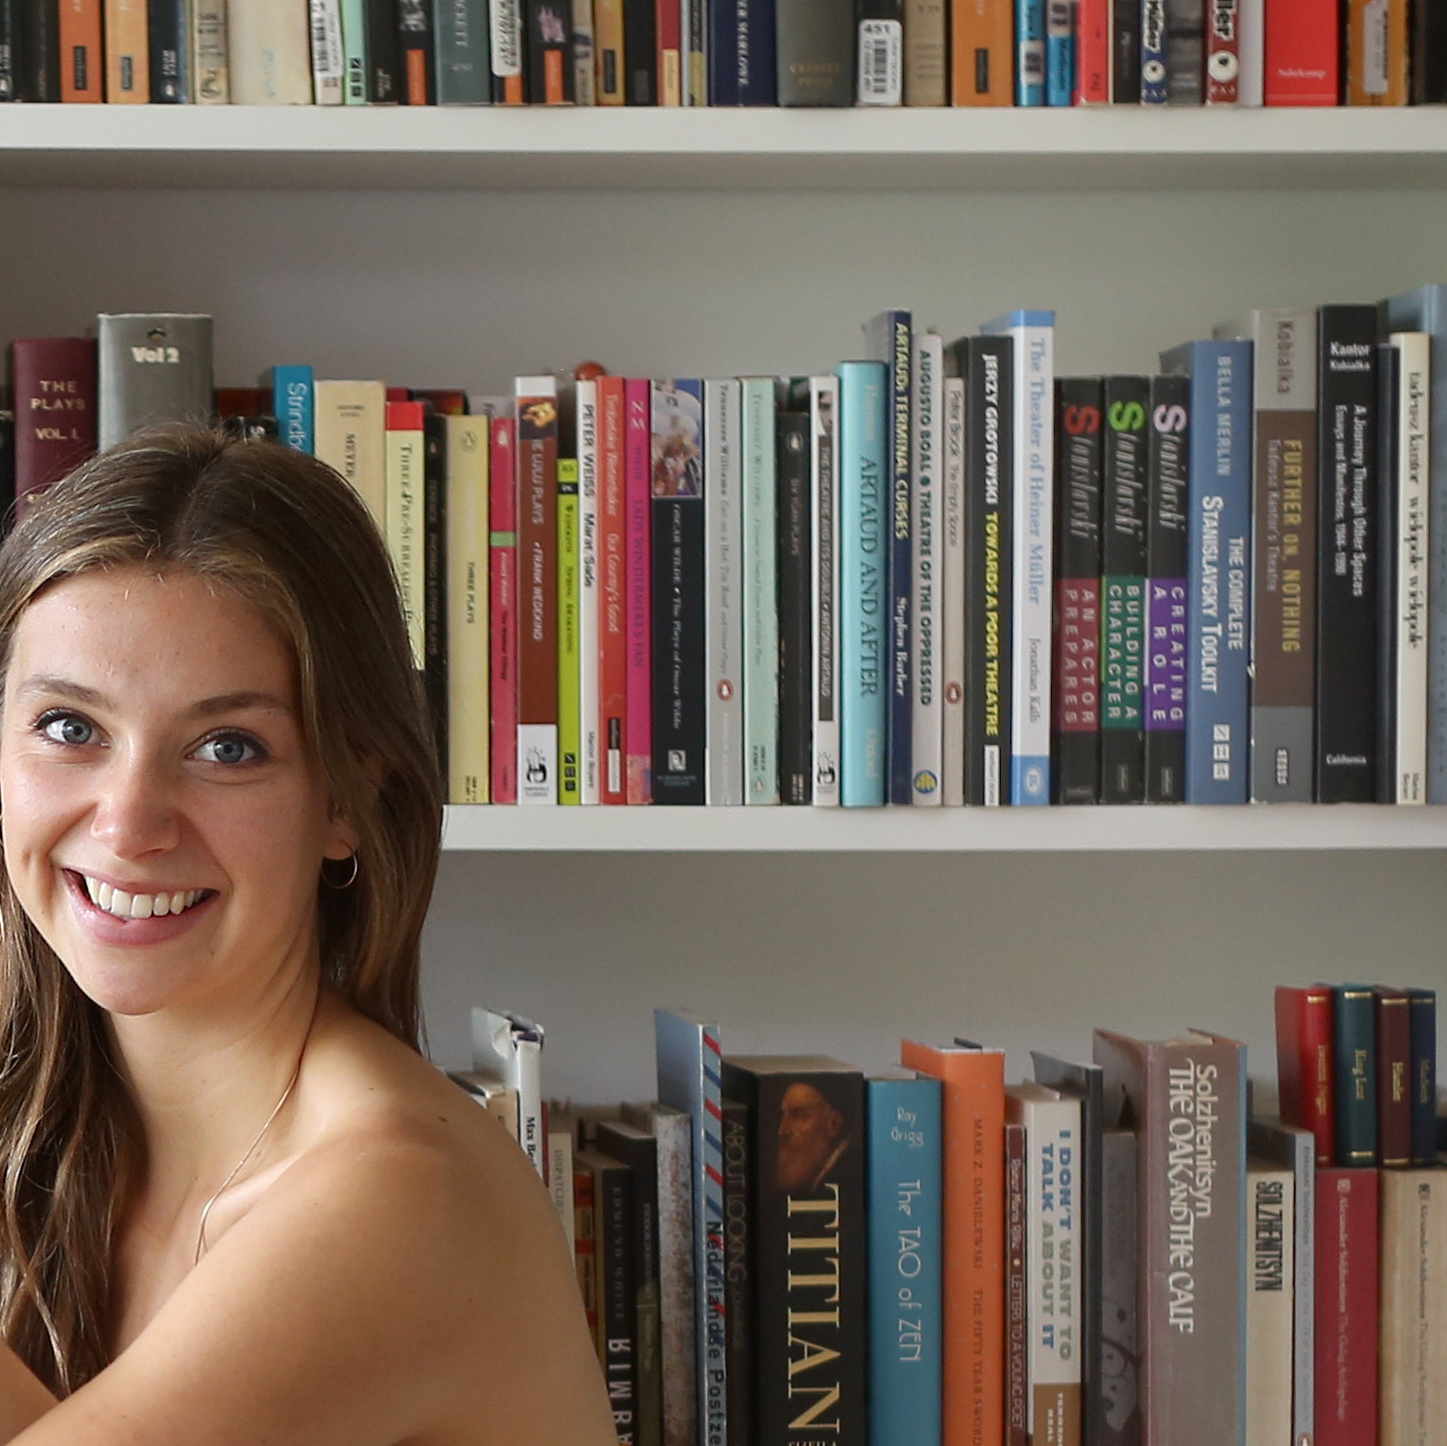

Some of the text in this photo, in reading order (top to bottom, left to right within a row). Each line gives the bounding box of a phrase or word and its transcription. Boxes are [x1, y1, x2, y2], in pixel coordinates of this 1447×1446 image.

[31, 398, 85, 410] PLAYS
[40, 380, 77, 392] THE
[131, 347, 180, 363] Vol 2
[1216, 356, 1232, 475] BELLA MERLIN
[1276, 320, 1294, 394] Kobialka
[895, 323, 909, 539] ARTAUD: TERMINAL CURSES
[1028, 339, 1045, 605] The Theater of Heiner Müller
[1282, 439, 1302, 525] FURTHER
[860, 456, 879, 696] ARTAUD AND AFTER
[983, 354, 999, 736] JERZY GROTOWSKI TOWARDS A POOR THEATRE
[1228, 537, 1244, 650] THE COMPLETE
[1281, 569, 1301, 653] NOTHING
[1187, 1064, 1218, 1218] Solzhenitsyn
[707, 1221, 725, 1359] Nederlandse
[897, 1180, 921, 1362] The TAO of ZEN
[1041, 1142, 1055, 1349] TALK ABOUT IT
[1058, 1130, 1072, 1361] I DON'T WANT TO
[1254, 1180, 1283, 1292] SOLZHENITSYN
[787, 1183, 840, 1436] TITIAN
